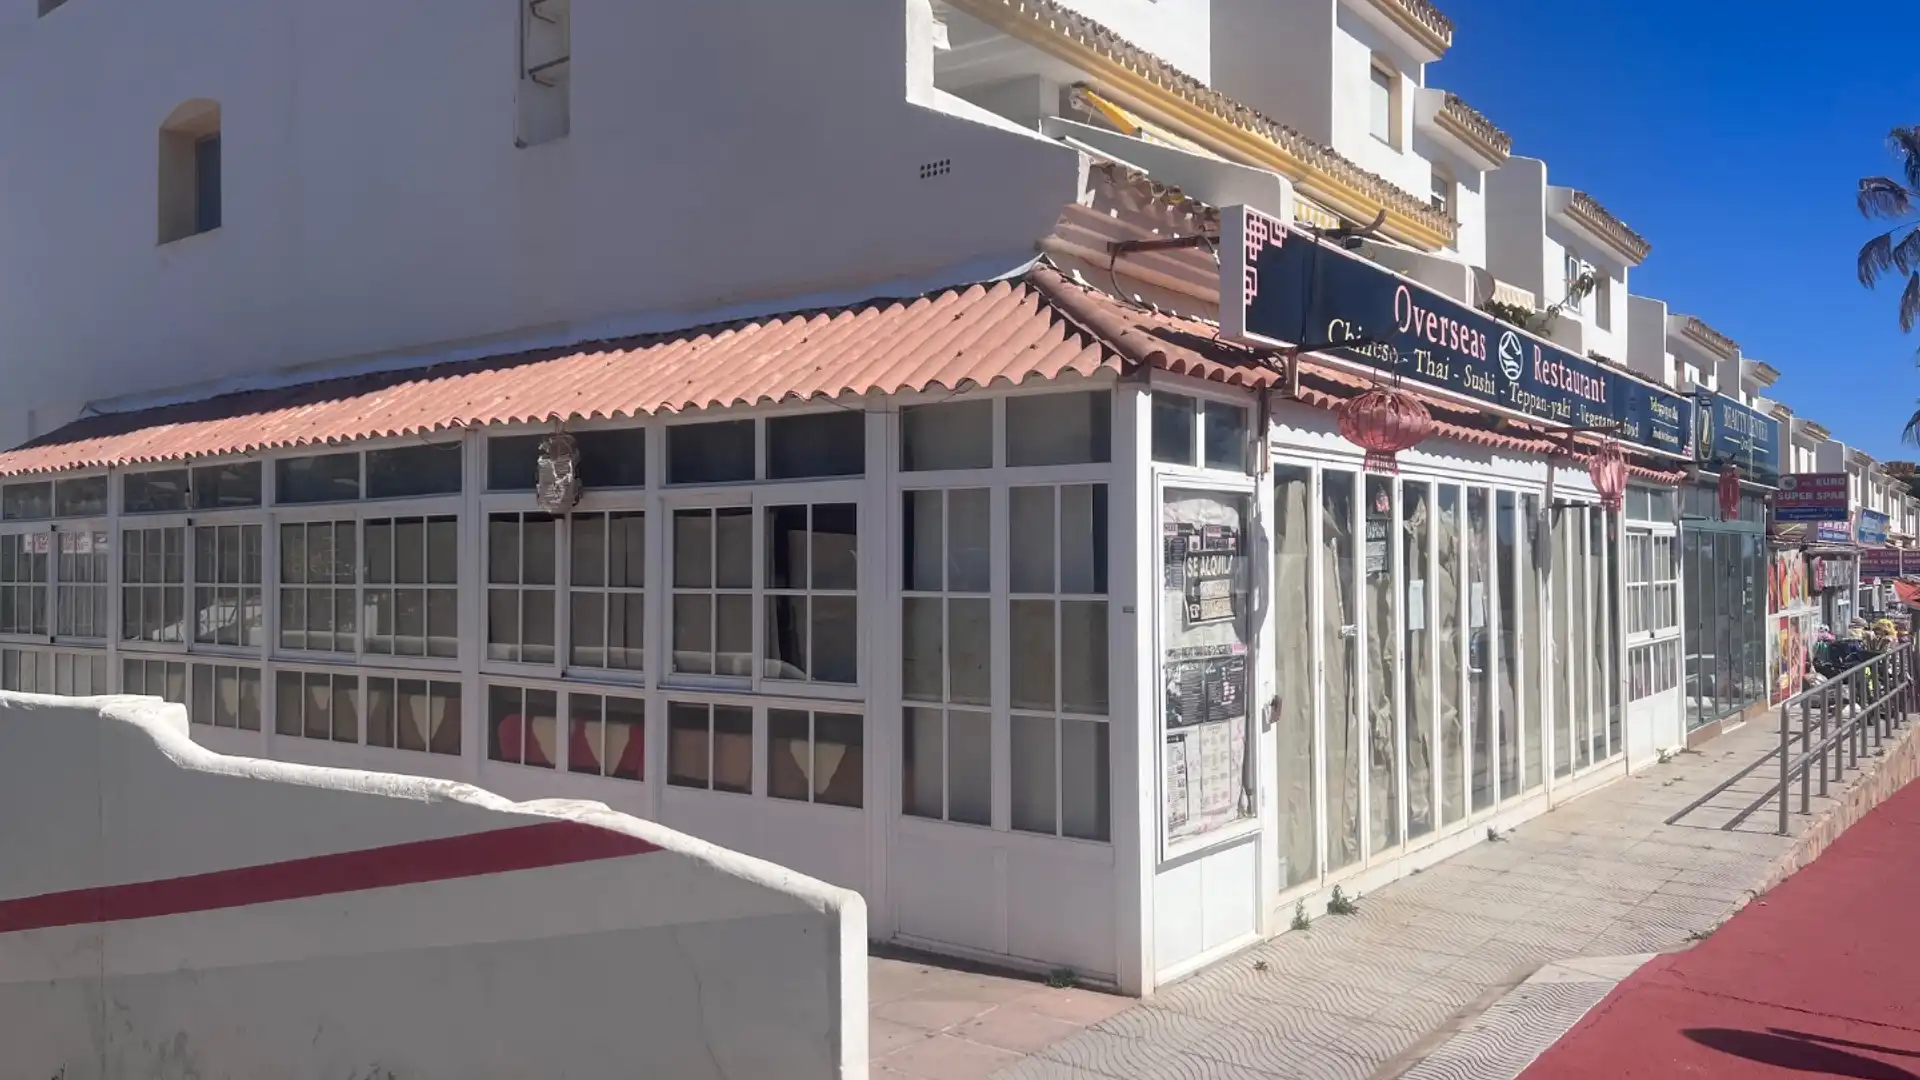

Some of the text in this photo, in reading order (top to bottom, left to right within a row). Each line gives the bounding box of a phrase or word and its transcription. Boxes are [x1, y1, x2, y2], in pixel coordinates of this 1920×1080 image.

[1394, 285, 1607, 404] Overseas Restaurant
[1414, 348, 1450, 381] Thai
[1463, 364, 1496, 396] Sushi
[1508, 380, 1572, 420] Teppan-yaki
[1623, 415, 1640, 438] food
[1816, 477, 1846, 486] EURO
[1777, 490, 1846, 500] SUPER SPAR
[1187, 556, 1199, 578] SE
